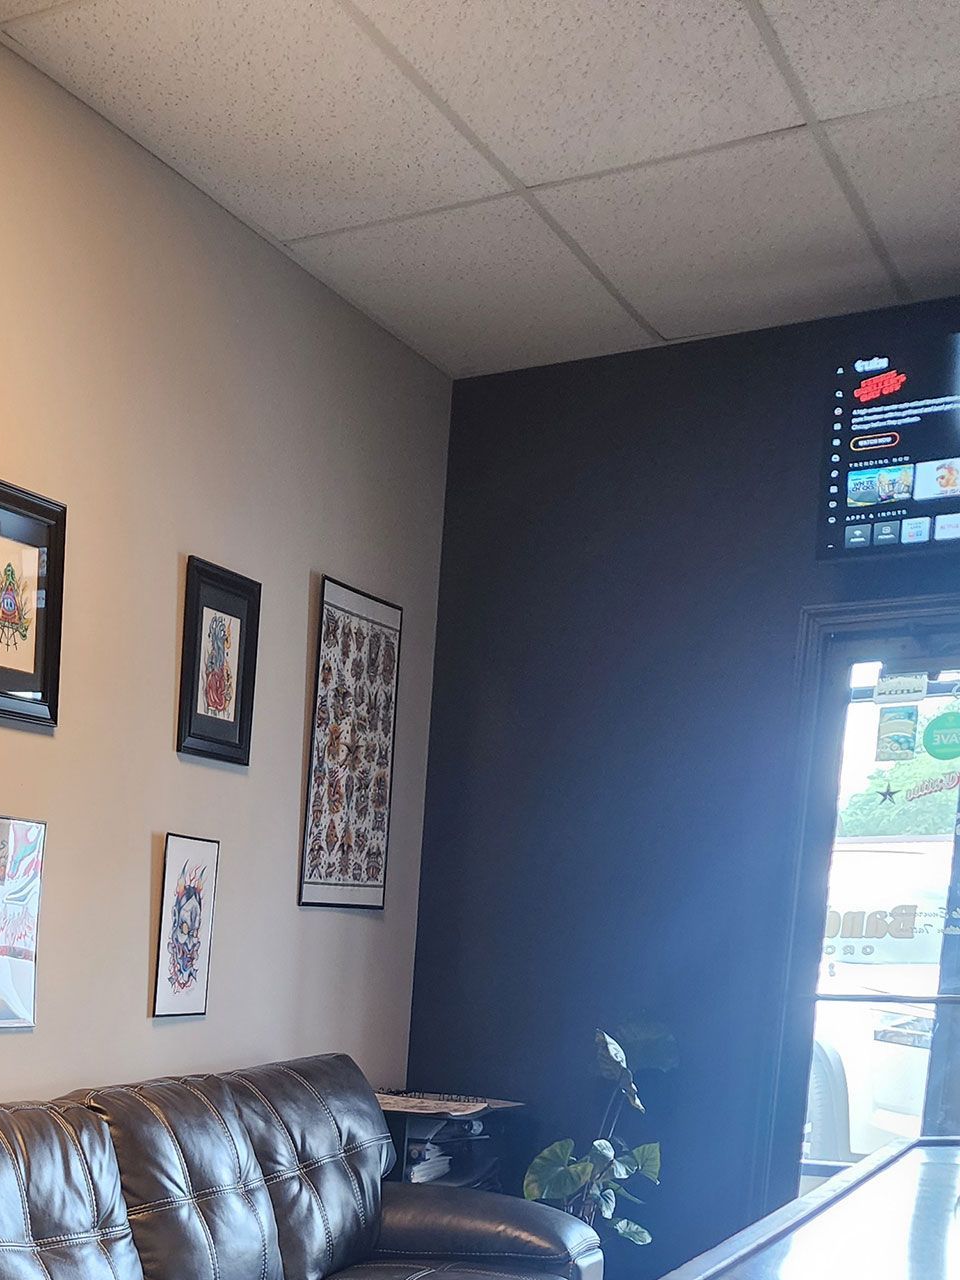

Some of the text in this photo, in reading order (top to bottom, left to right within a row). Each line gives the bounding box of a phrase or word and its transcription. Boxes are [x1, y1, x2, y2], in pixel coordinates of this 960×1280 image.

[849, 458, 889, 468] TRENDING
[845, 514, 866, 522] APPS
[877, 509, 908, 518] INPUTS
